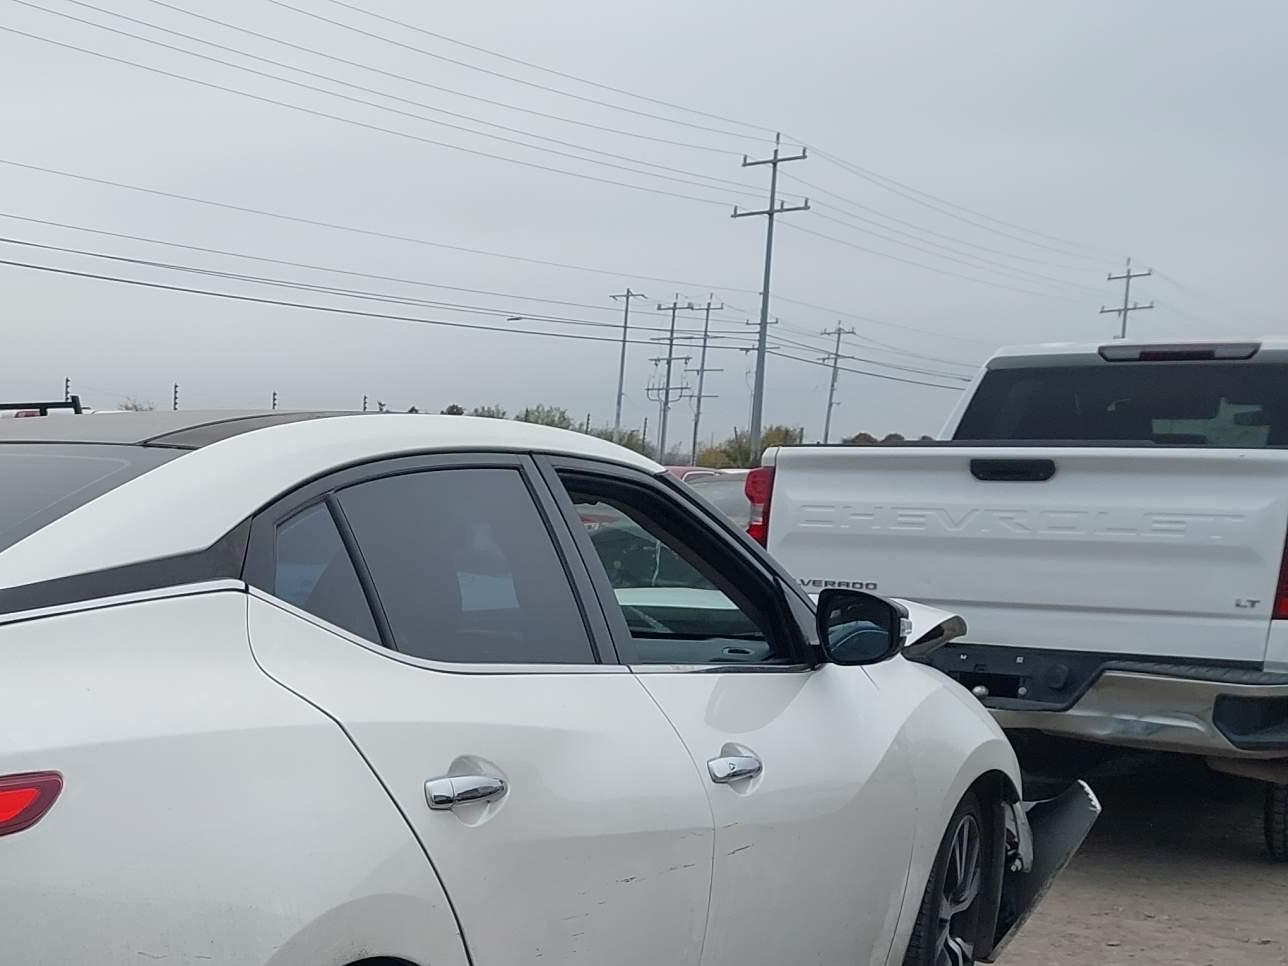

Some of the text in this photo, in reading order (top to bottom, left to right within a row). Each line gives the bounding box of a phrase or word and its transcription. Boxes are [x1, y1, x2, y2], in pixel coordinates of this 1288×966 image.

[798, 504, 1246, 540] CHEVROLET
[797, 578, 878, 591] VERADO
[1235, 598, 1261, 609] LT
